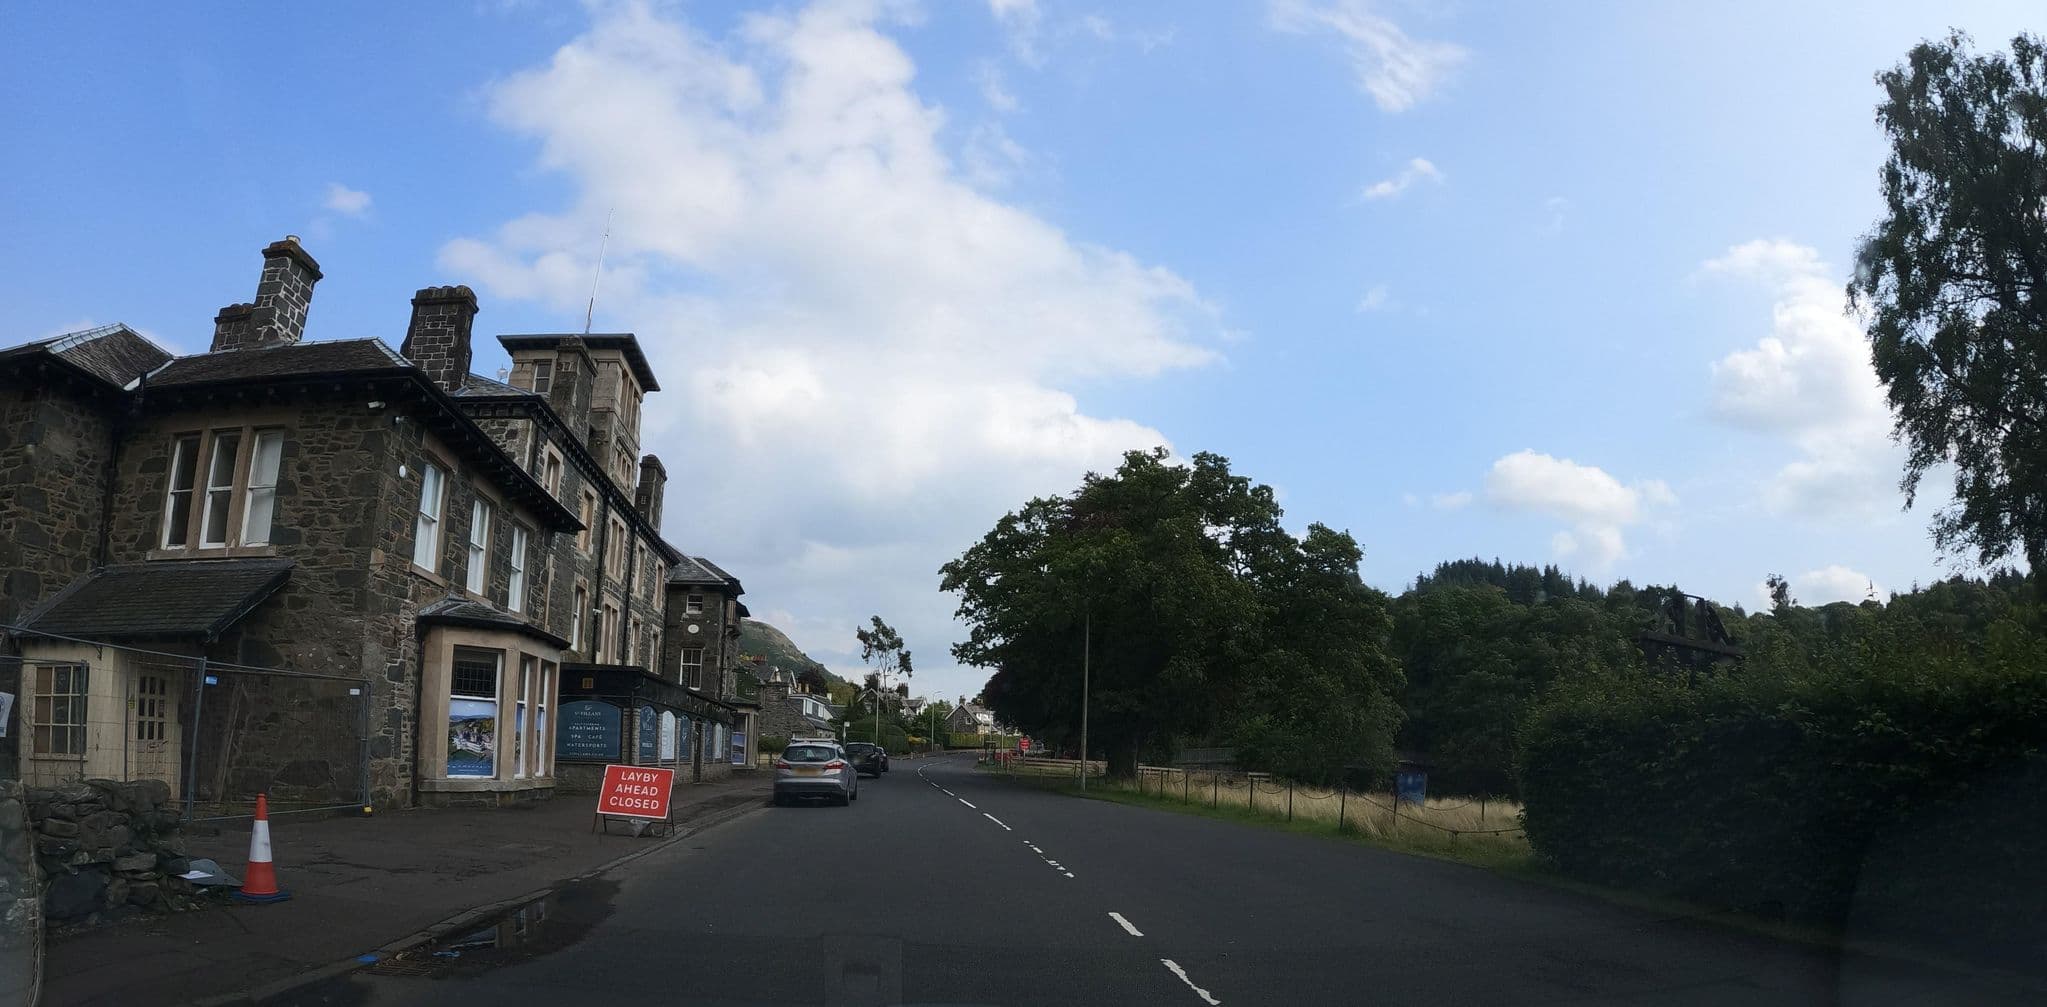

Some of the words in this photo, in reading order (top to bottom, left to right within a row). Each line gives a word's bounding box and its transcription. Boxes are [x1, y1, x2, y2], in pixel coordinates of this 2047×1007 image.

[621, 771, 659, 783] LAYBY
[615, 783, 658, 797] AHEAD
[609, 796, 660, 810] CLOSED
